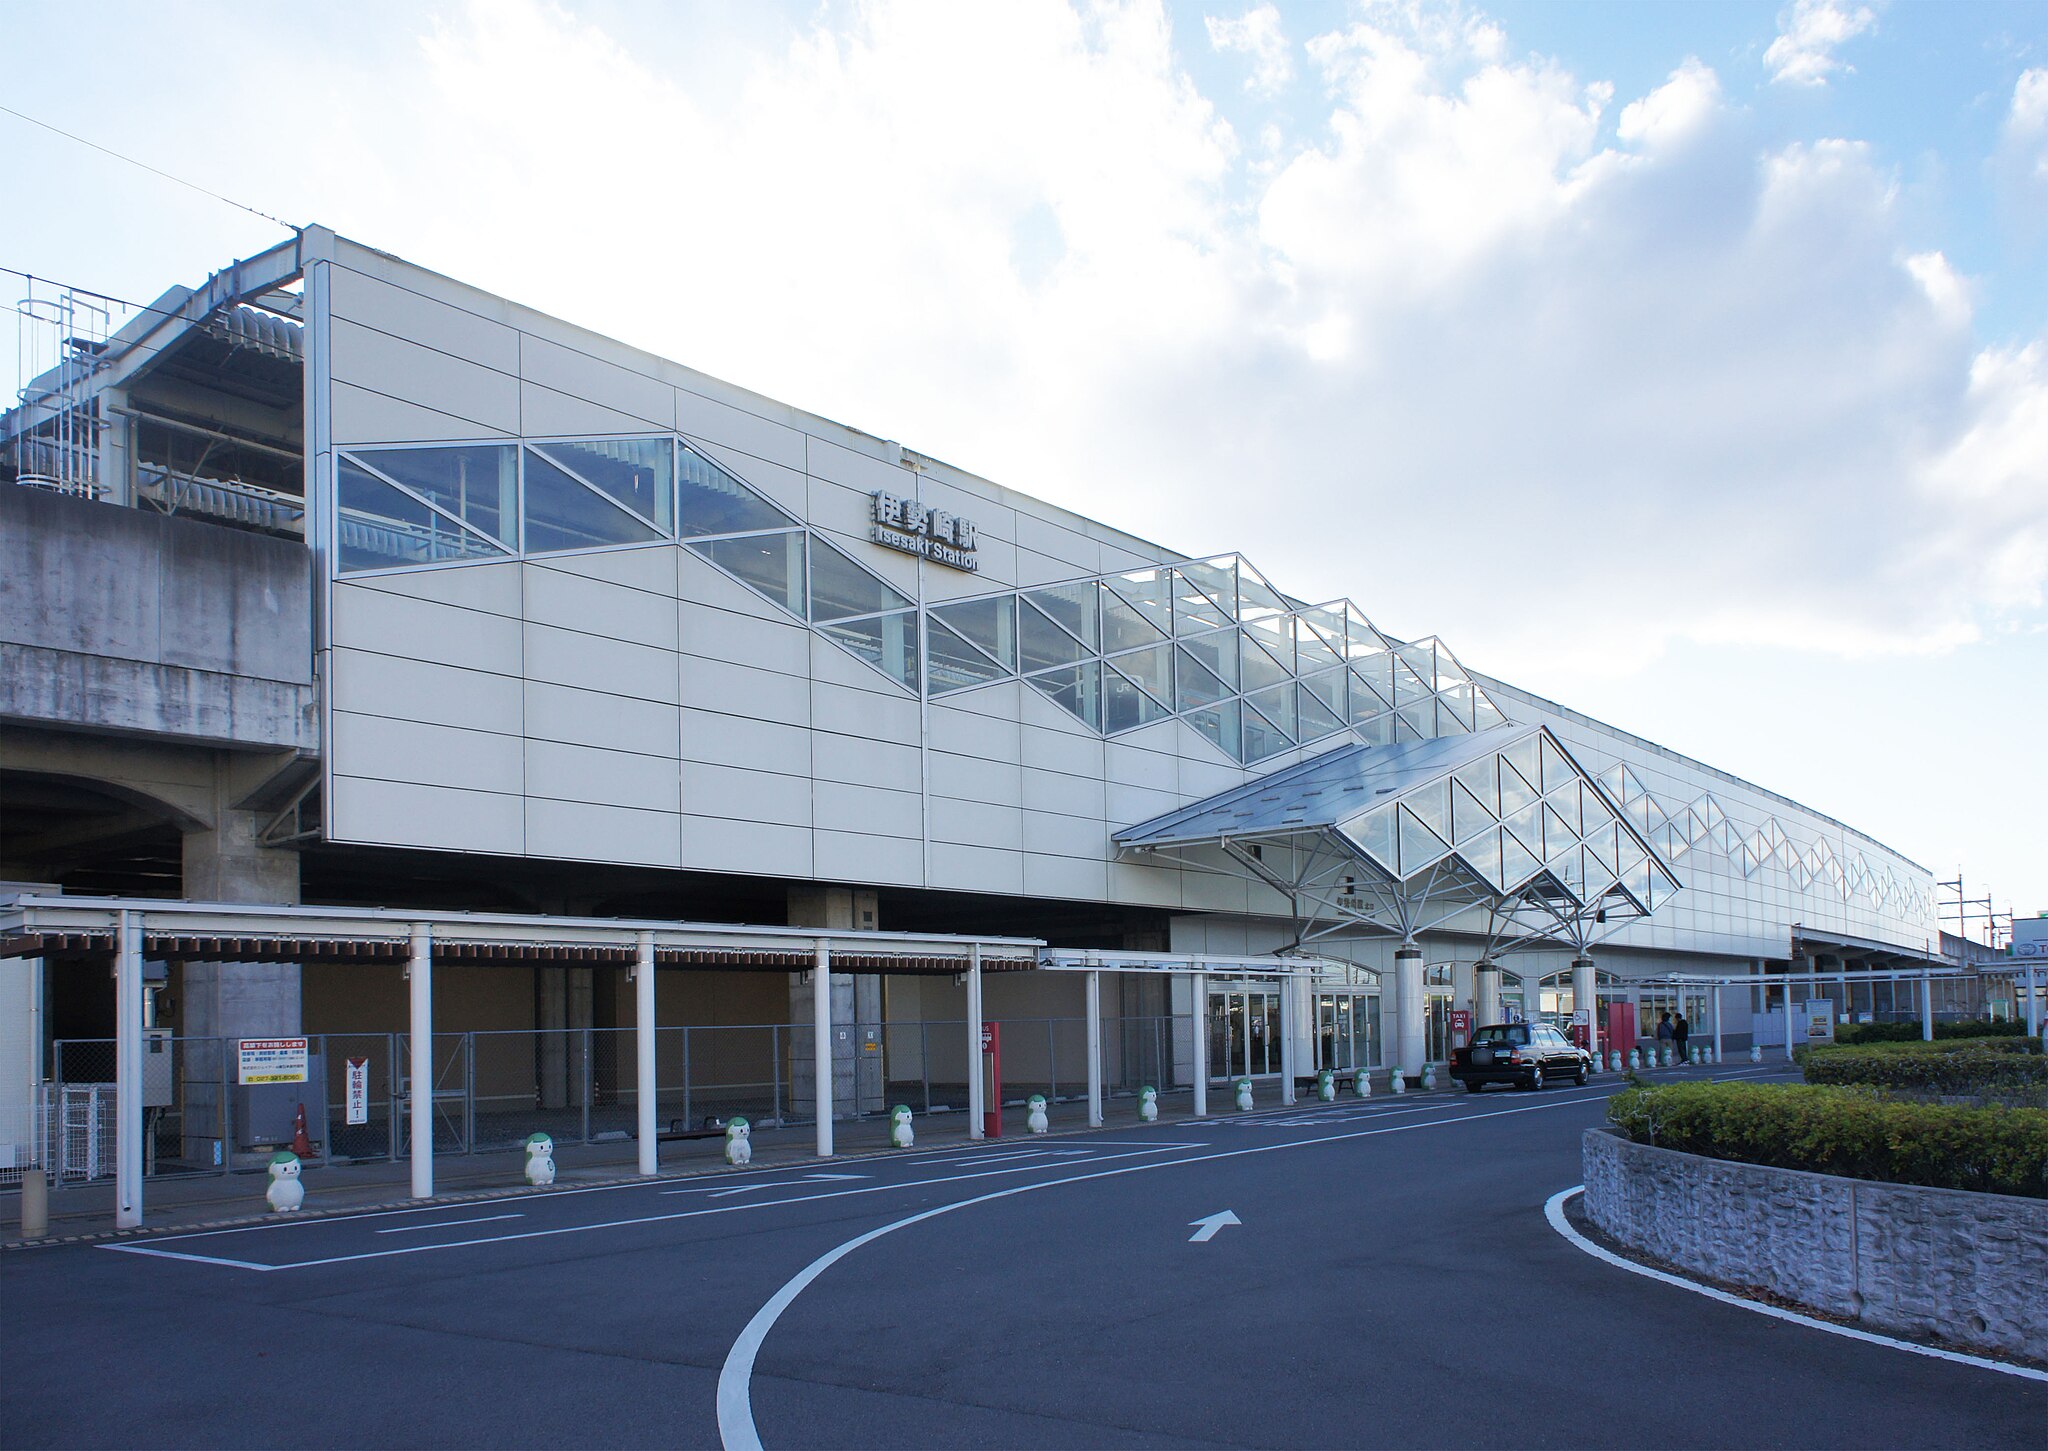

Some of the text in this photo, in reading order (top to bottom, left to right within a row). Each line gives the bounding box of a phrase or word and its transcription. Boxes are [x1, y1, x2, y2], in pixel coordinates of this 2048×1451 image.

[875, 490, 979, 551] 伊勢崎駅
[877, 525, 979, 570] Isesaki Station
[1116, 683, 1129, 692] JR
